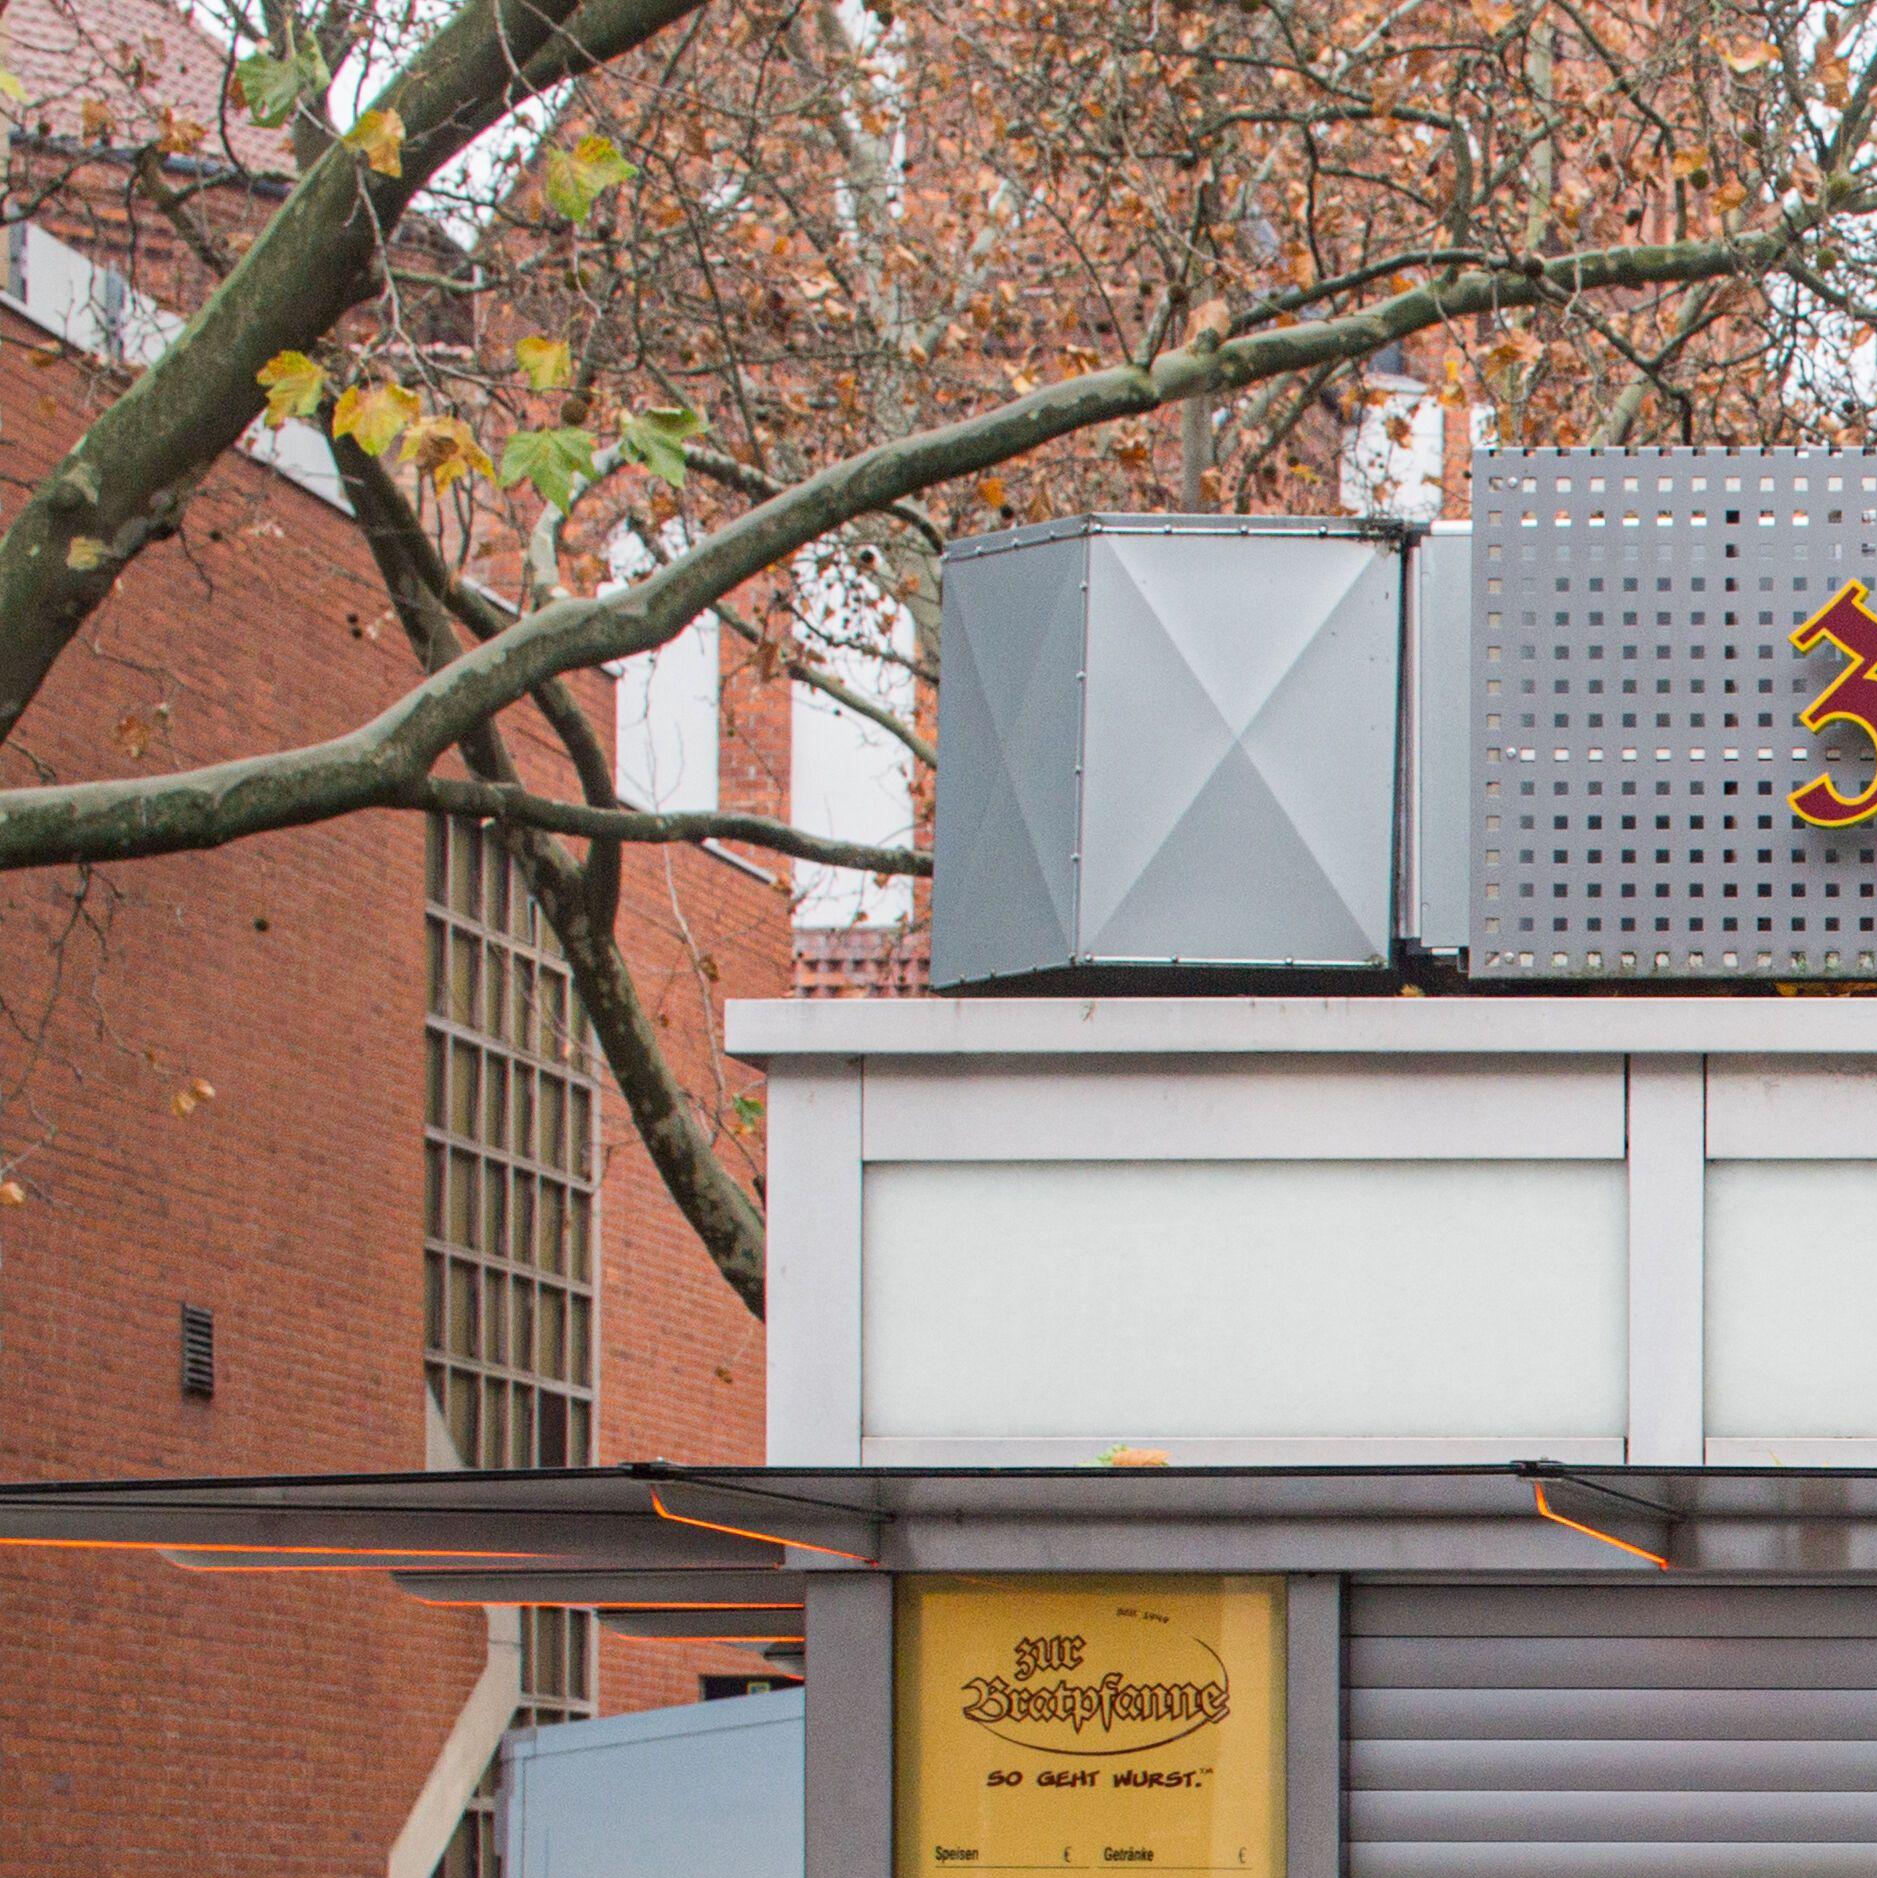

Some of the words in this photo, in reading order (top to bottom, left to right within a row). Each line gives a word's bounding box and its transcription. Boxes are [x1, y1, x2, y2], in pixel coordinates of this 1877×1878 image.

[1014, 1633, 1087, 1680] zur
[962, 1672, 1231, 1734] Bratpfanne
[987, 1771, 1023, 1788] SO
[1037, 1770, 1099, 1788] GEHT
[935, 1845, 978, 1863] Speisen
[1104, 1847, 1154, 1861] Getränke
[1238, 1847, 1246, 1863] €
